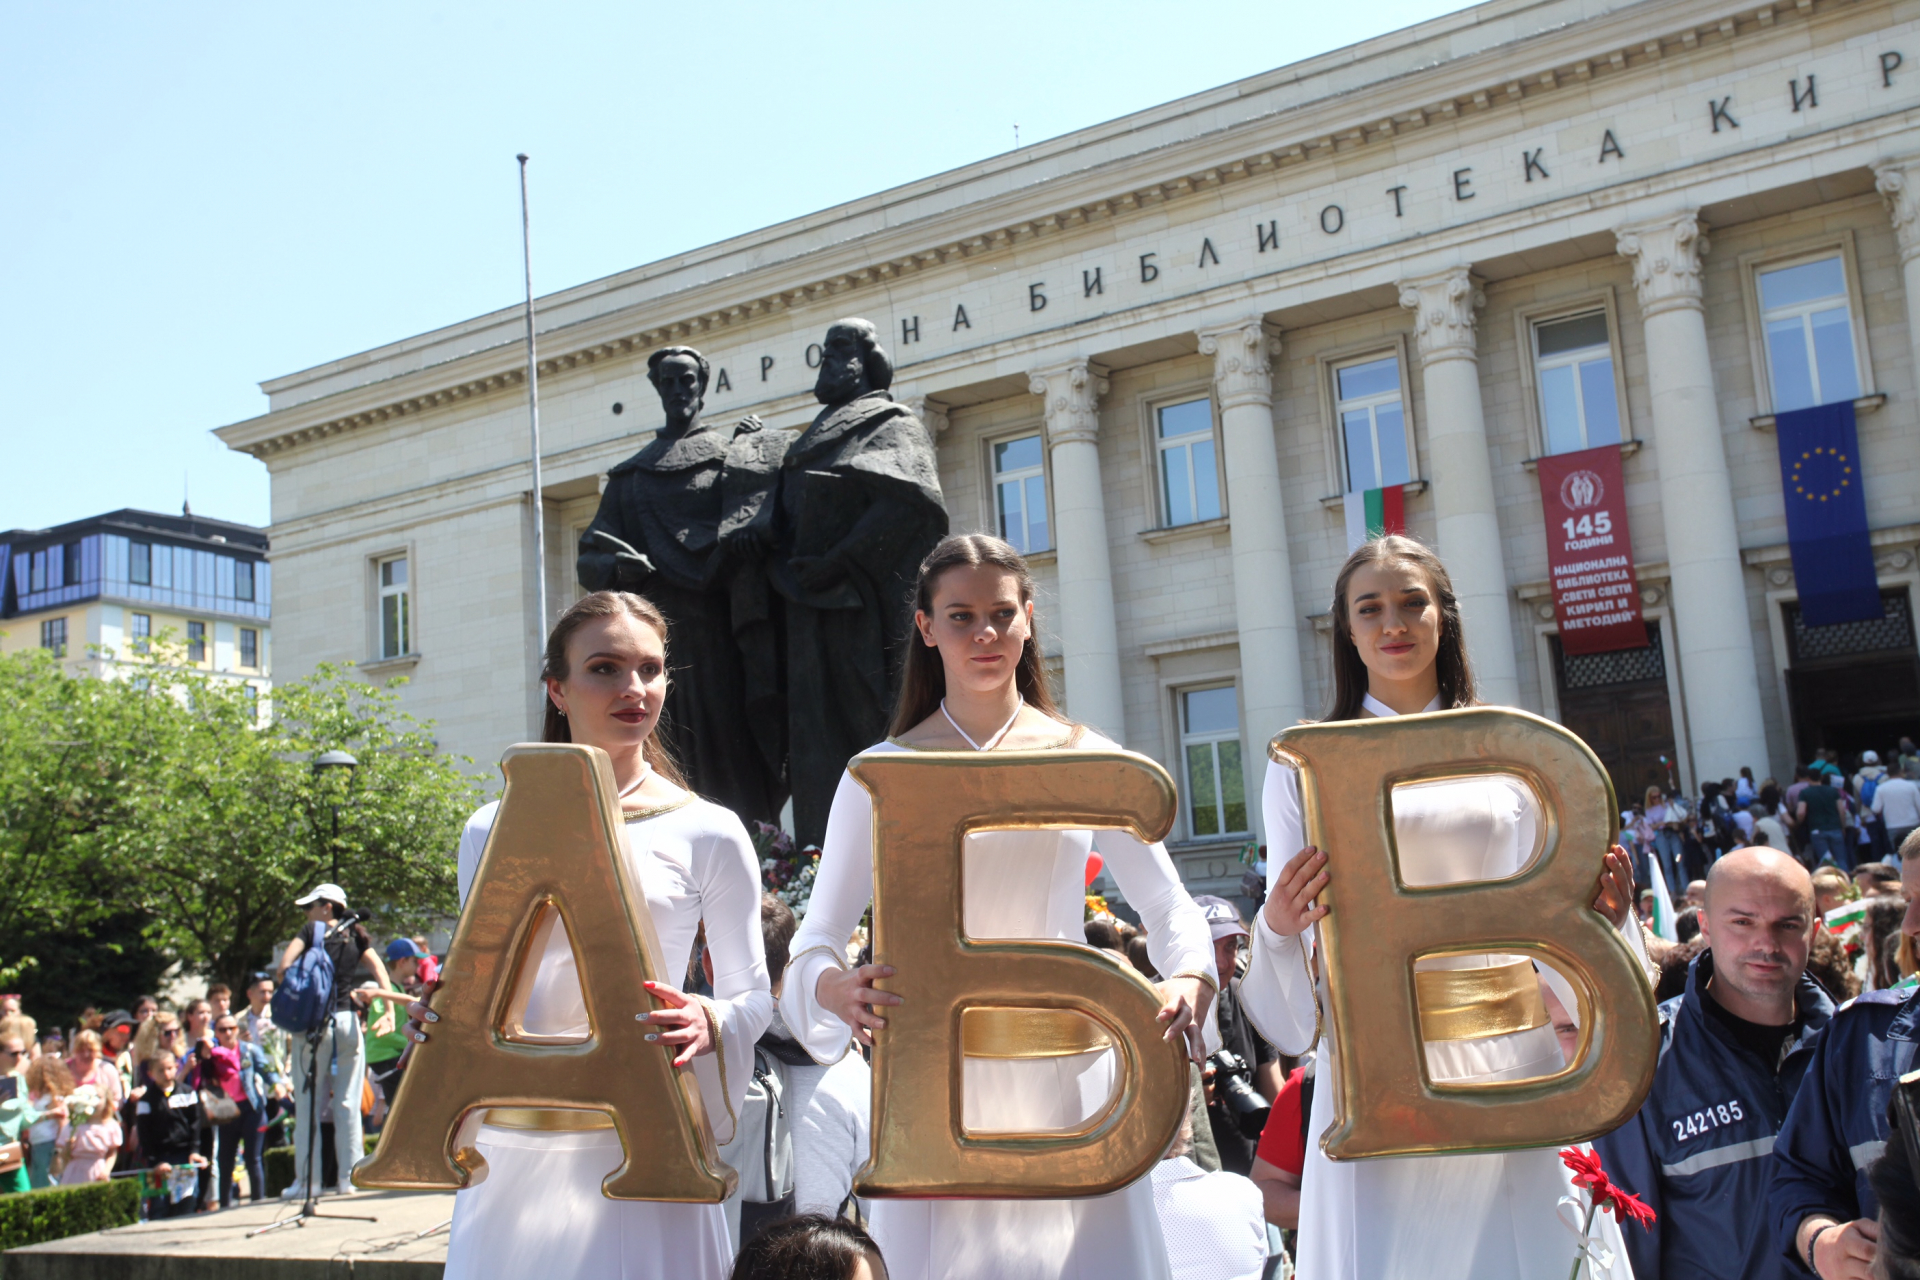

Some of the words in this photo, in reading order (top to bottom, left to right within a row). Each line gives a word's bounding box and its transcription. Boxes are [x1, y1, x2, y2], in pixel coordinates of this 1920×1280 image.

[1028, 129, 1625, 313] БИБЛИОТЕКА
[1562, 510, 1612, 539] 145
[1564, 534, 1614, 551] ГОДИНИ
[1554, 555, 1628, 576] НАЦИОНАЛНА
[1556, 569, 1629, 589] БИБЛИОТЕКА
[1597, 583, 1632, 598] СВЕТИ
[1566, 600, 1614, 617] КИРИЛ
[1617, 598, 1628, 609] И
[1672, 1100, 1744, 1142] 242185
